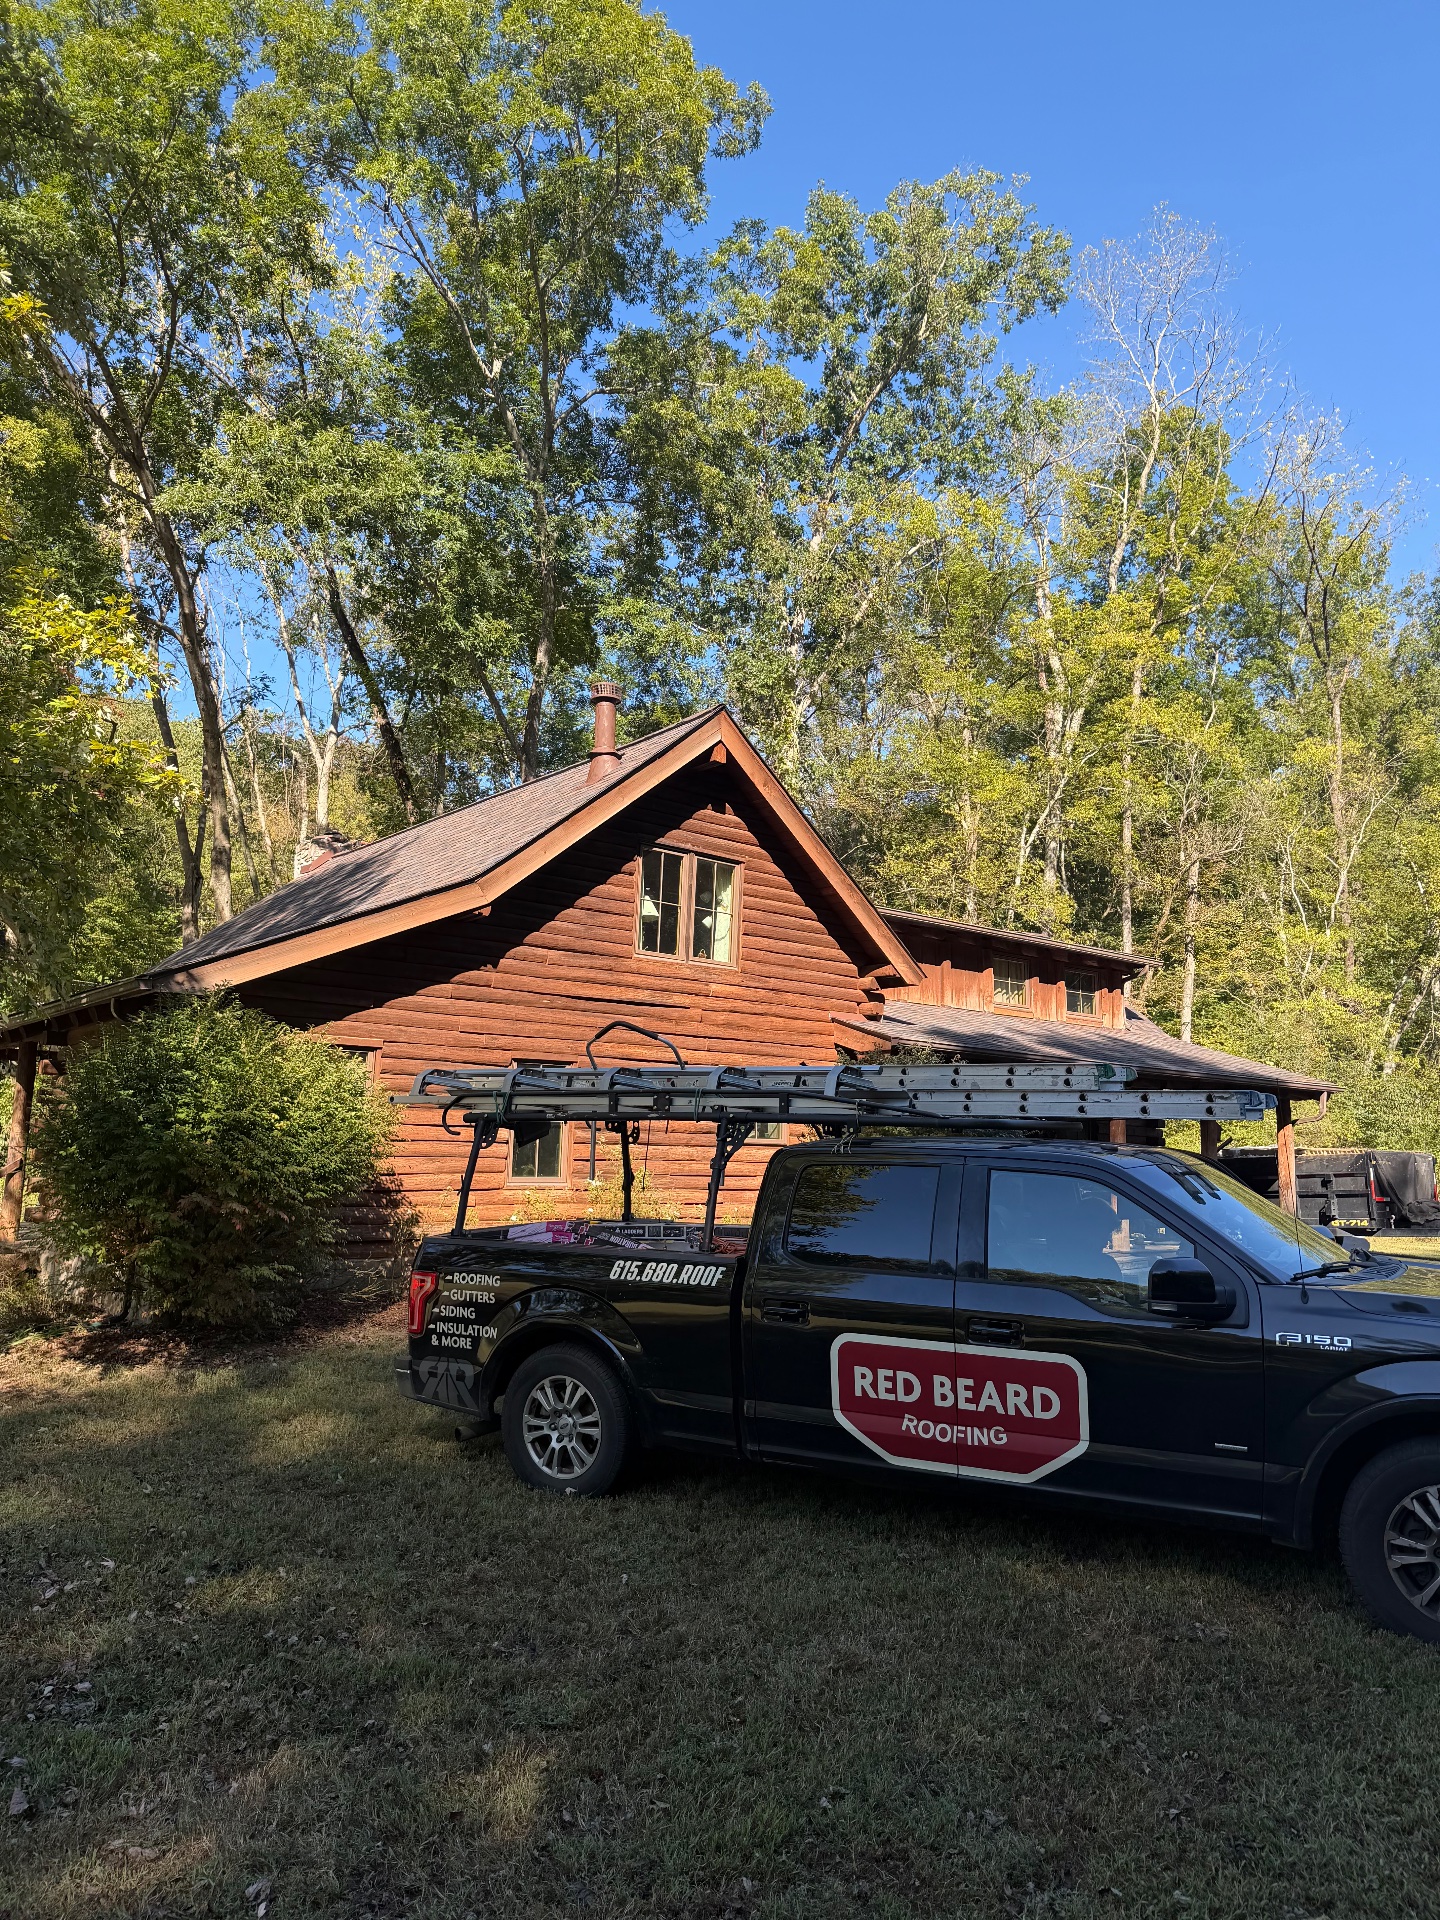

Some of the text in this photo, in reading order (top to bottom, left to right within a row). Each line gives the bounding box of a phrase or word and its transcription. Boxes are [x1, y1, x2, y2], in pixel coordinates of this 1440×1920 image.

[1331, 1219, 1369, 1227] GT-714
[453, 1272, 501, 1287] ROOFING
[609, 1260, 727, 1287] 615.680.ROOF
[450, 1288, 496, 1304] GUTTERS
[440, 1305, 476, 1319] SIDING
[436, 1321, 498, 1339] INSULATION
[431, 1334, 473, 1350] & MORE
[853, 1365, 1062, 1420] RED BEARD
[901, 1413, 1008, 1446] ROOFING
